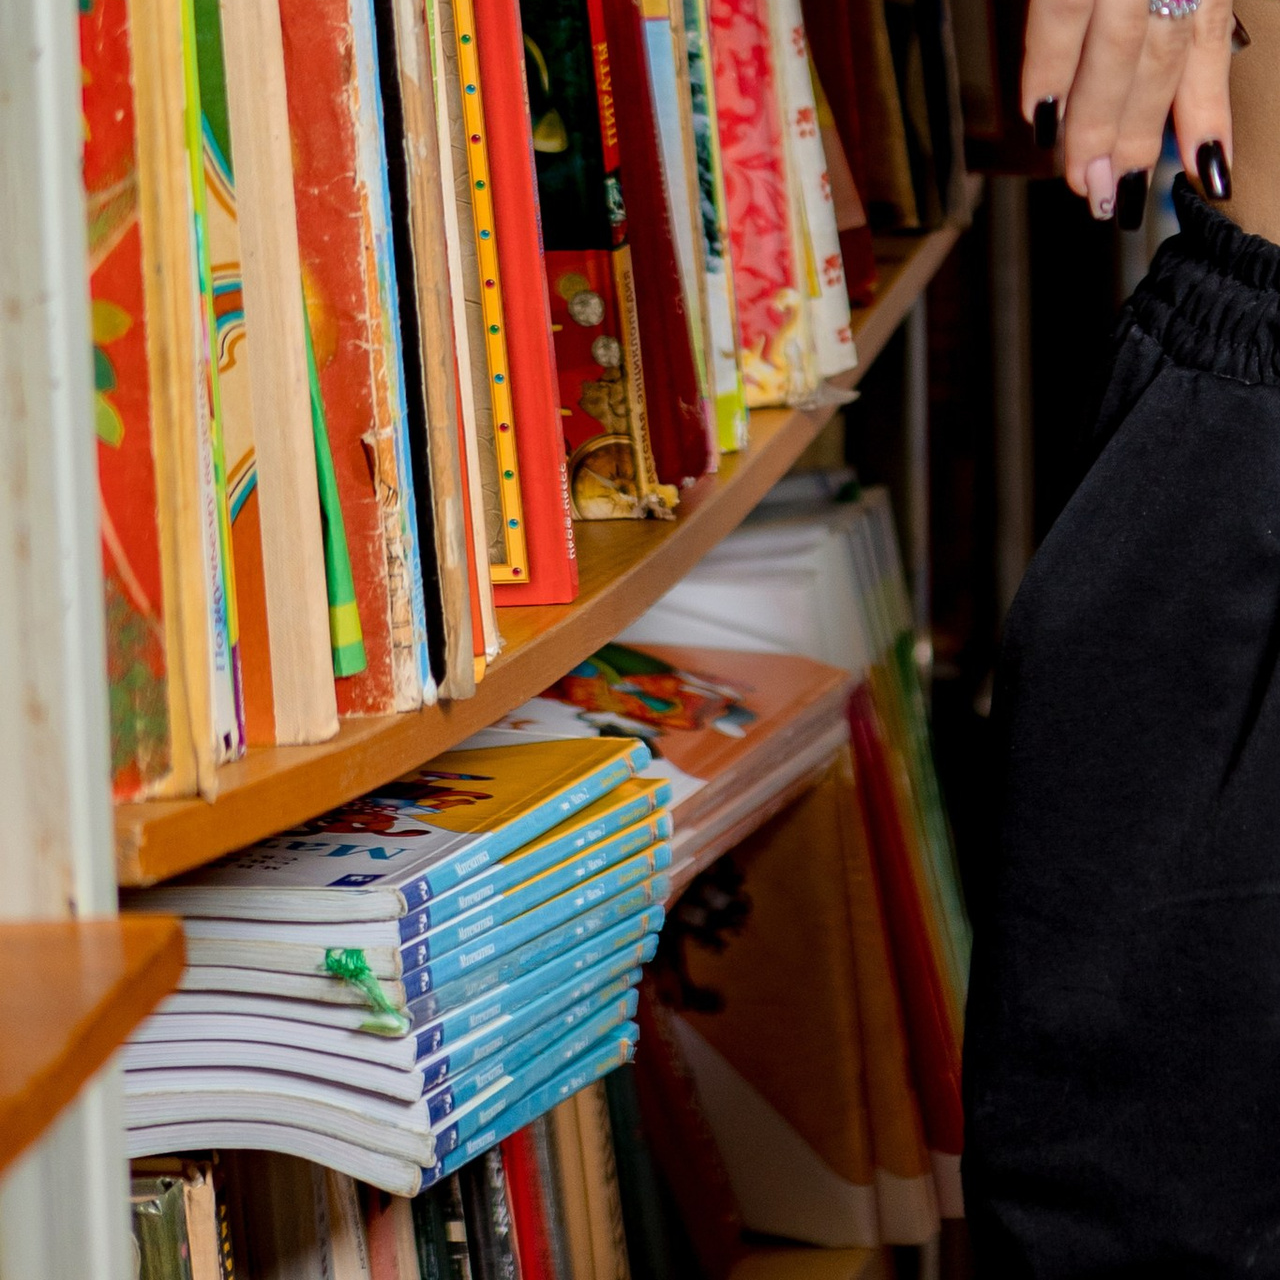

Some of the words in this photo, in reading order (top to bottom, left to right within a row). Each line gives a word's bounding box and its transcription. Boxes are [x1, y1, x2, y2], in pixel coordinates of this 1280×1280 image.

[591, 41, 618, 148] ПИРАТЫ
[622, 268, 645, 405] ЭНЦИКЛОПЕДИЯ
[638, 409, 656, 485] ДЕТСКАЯ
[454, 850, 491, 878] Математика
